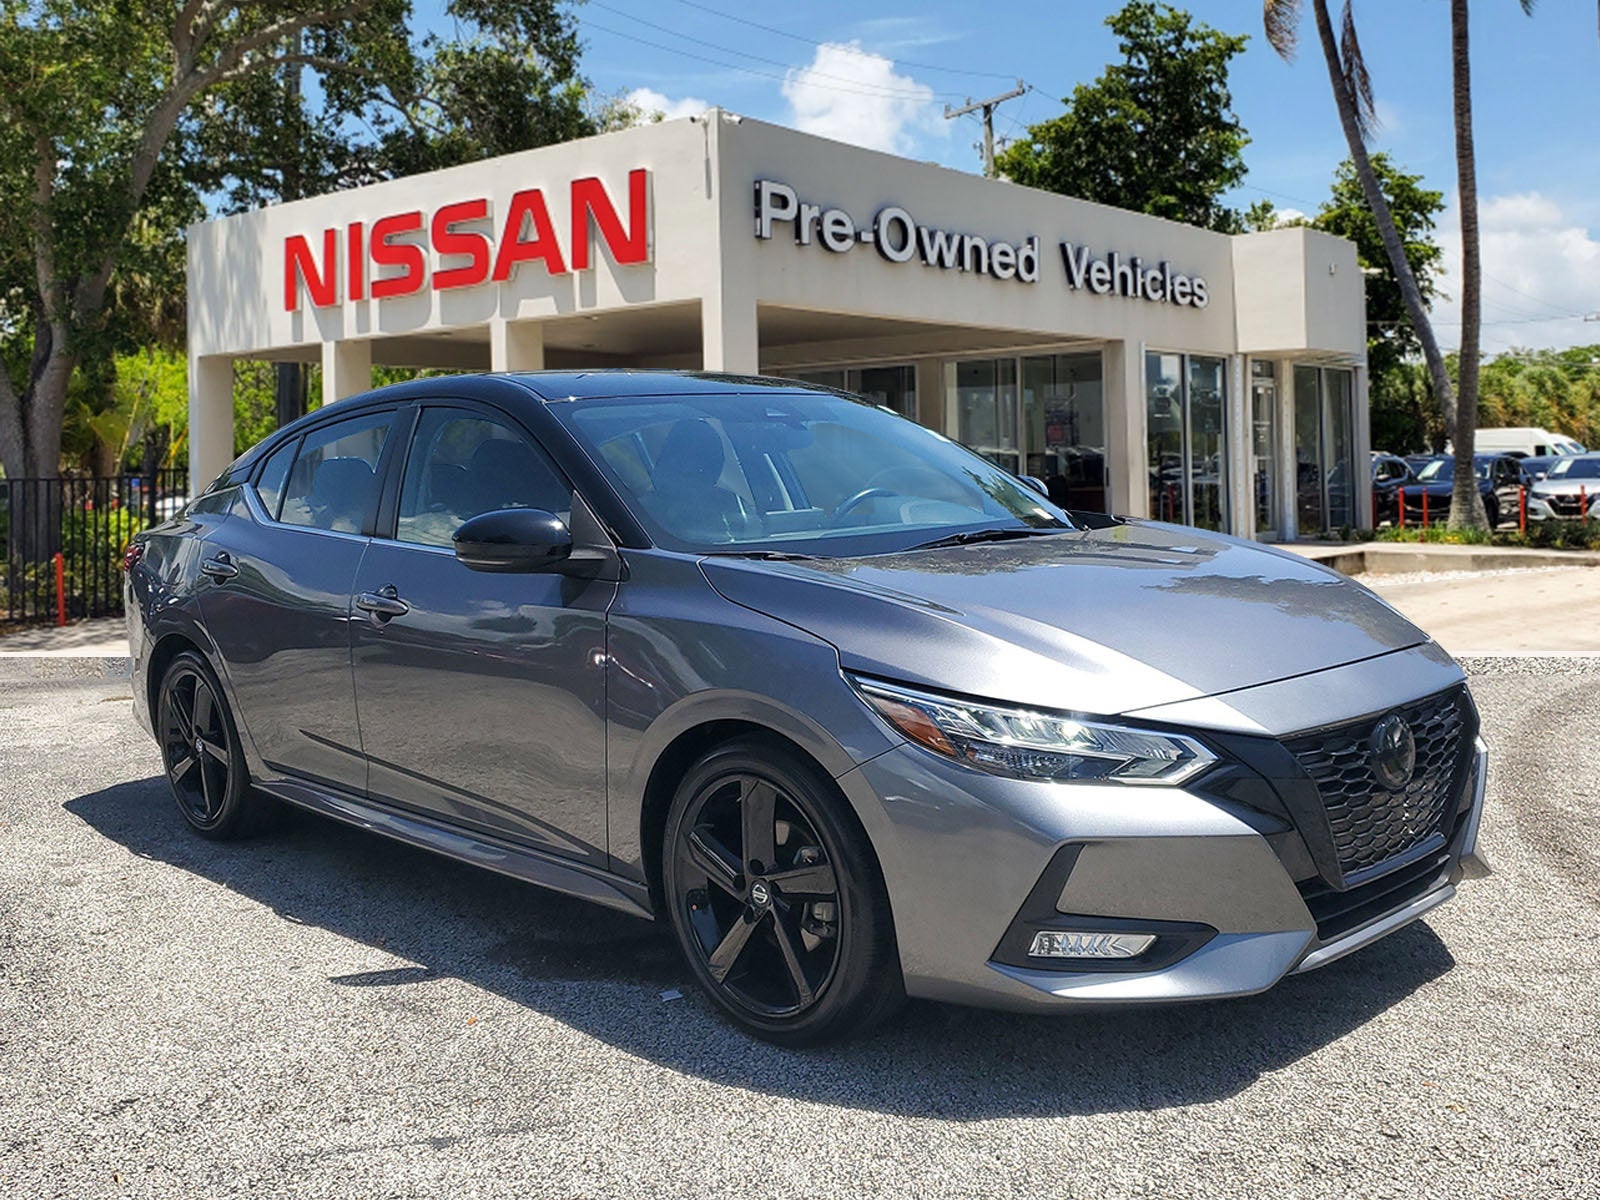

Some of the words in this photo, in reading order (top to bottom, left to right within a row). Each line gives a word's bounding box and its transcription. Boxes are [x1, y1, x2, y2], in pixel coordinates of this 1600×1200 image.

[285, 169, 648, 312] NISSAN
[755, 180, 1040, 283] Pre-Owned
[1060, 242, 1209, 308] Vehicles
